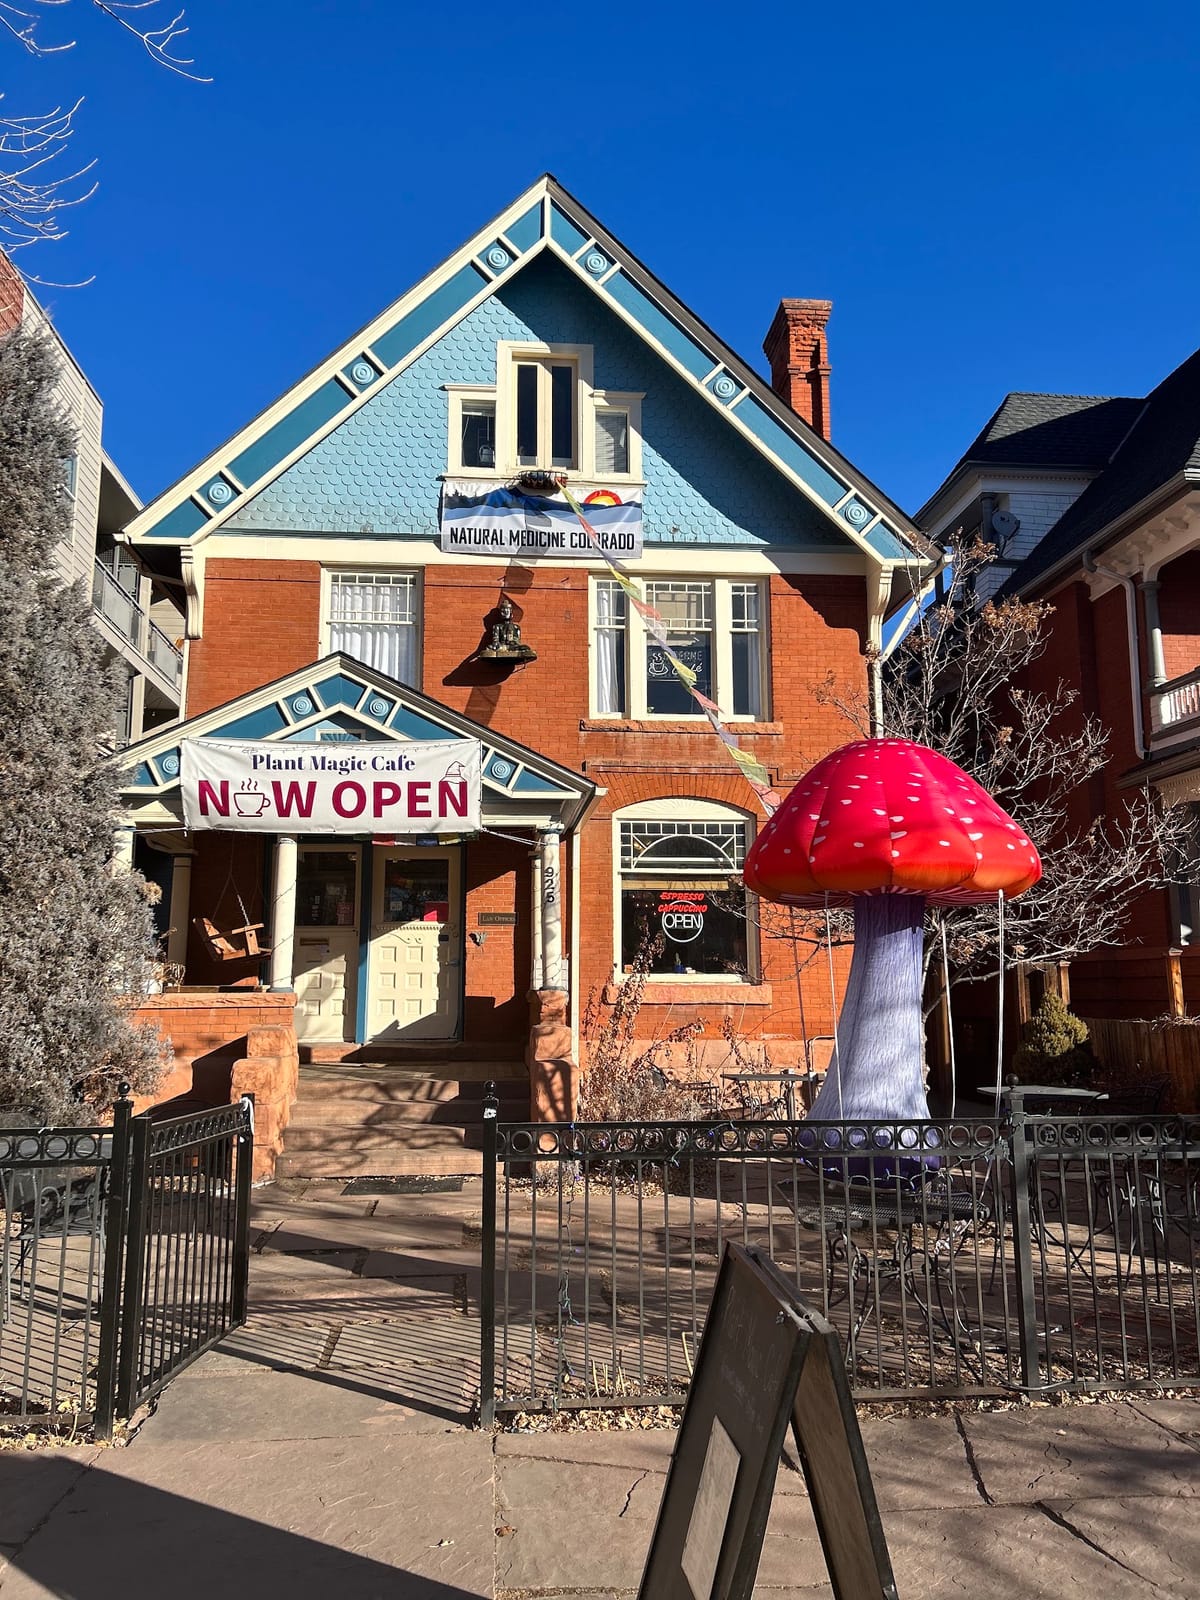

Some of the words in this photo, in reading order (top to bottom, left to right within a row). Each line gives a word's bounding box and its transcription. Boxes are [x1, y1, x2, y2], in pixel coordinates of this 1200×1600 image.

[450, 527, 505, 546] NATURAL
[509, 529, 565, 548] MEDICINE
[251, 754, 305, 771] Plant
[311, 755, 366, 776] Magic
[331, 781, 468, 818] OPEN
[543, 866, 555, 903] 925
[660, 892, 704, 900] ESPRESSO
[658, 904, 707, 913] CAPPUCCINO
[664, 914, 701, 928] OPEN
